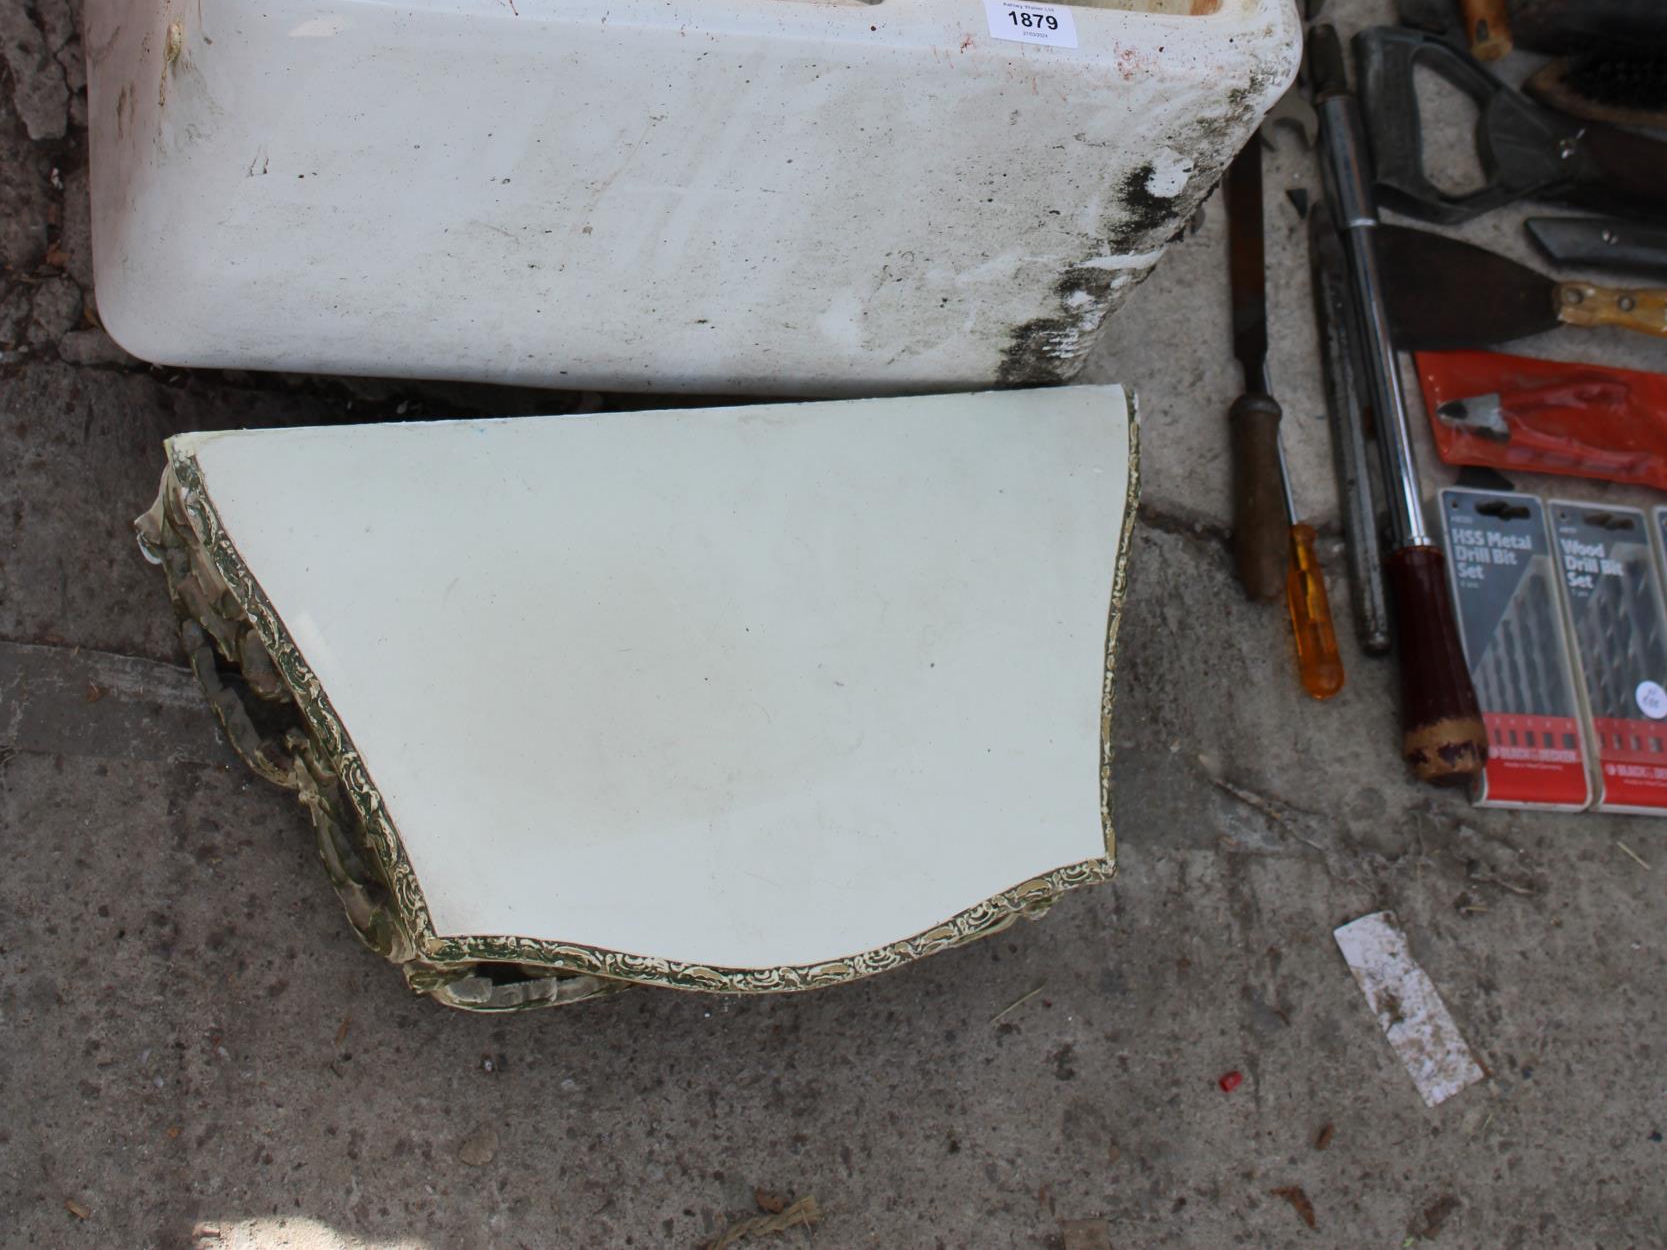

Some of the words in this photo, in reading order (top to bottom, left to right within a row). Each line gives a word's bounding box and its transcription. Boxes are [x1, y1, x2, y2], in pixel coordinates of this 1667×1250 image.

[1008, 10, 1058, 30] 1879
[1452, 529, 1485, 546] HSS
[1487, 532, 1532, 549] Metal
[1561, 539, 1605, 558] Wood
[1455, 545, 1490, 563] Drill
[1491, 547, 1517, 565] Bit
[1457, 562, 1485, 580] Set
[1565, 555, 1600, 574] Drill
[1600, 558, 1624, 576] Bit
[1567, 571, 1594, 589] Set
